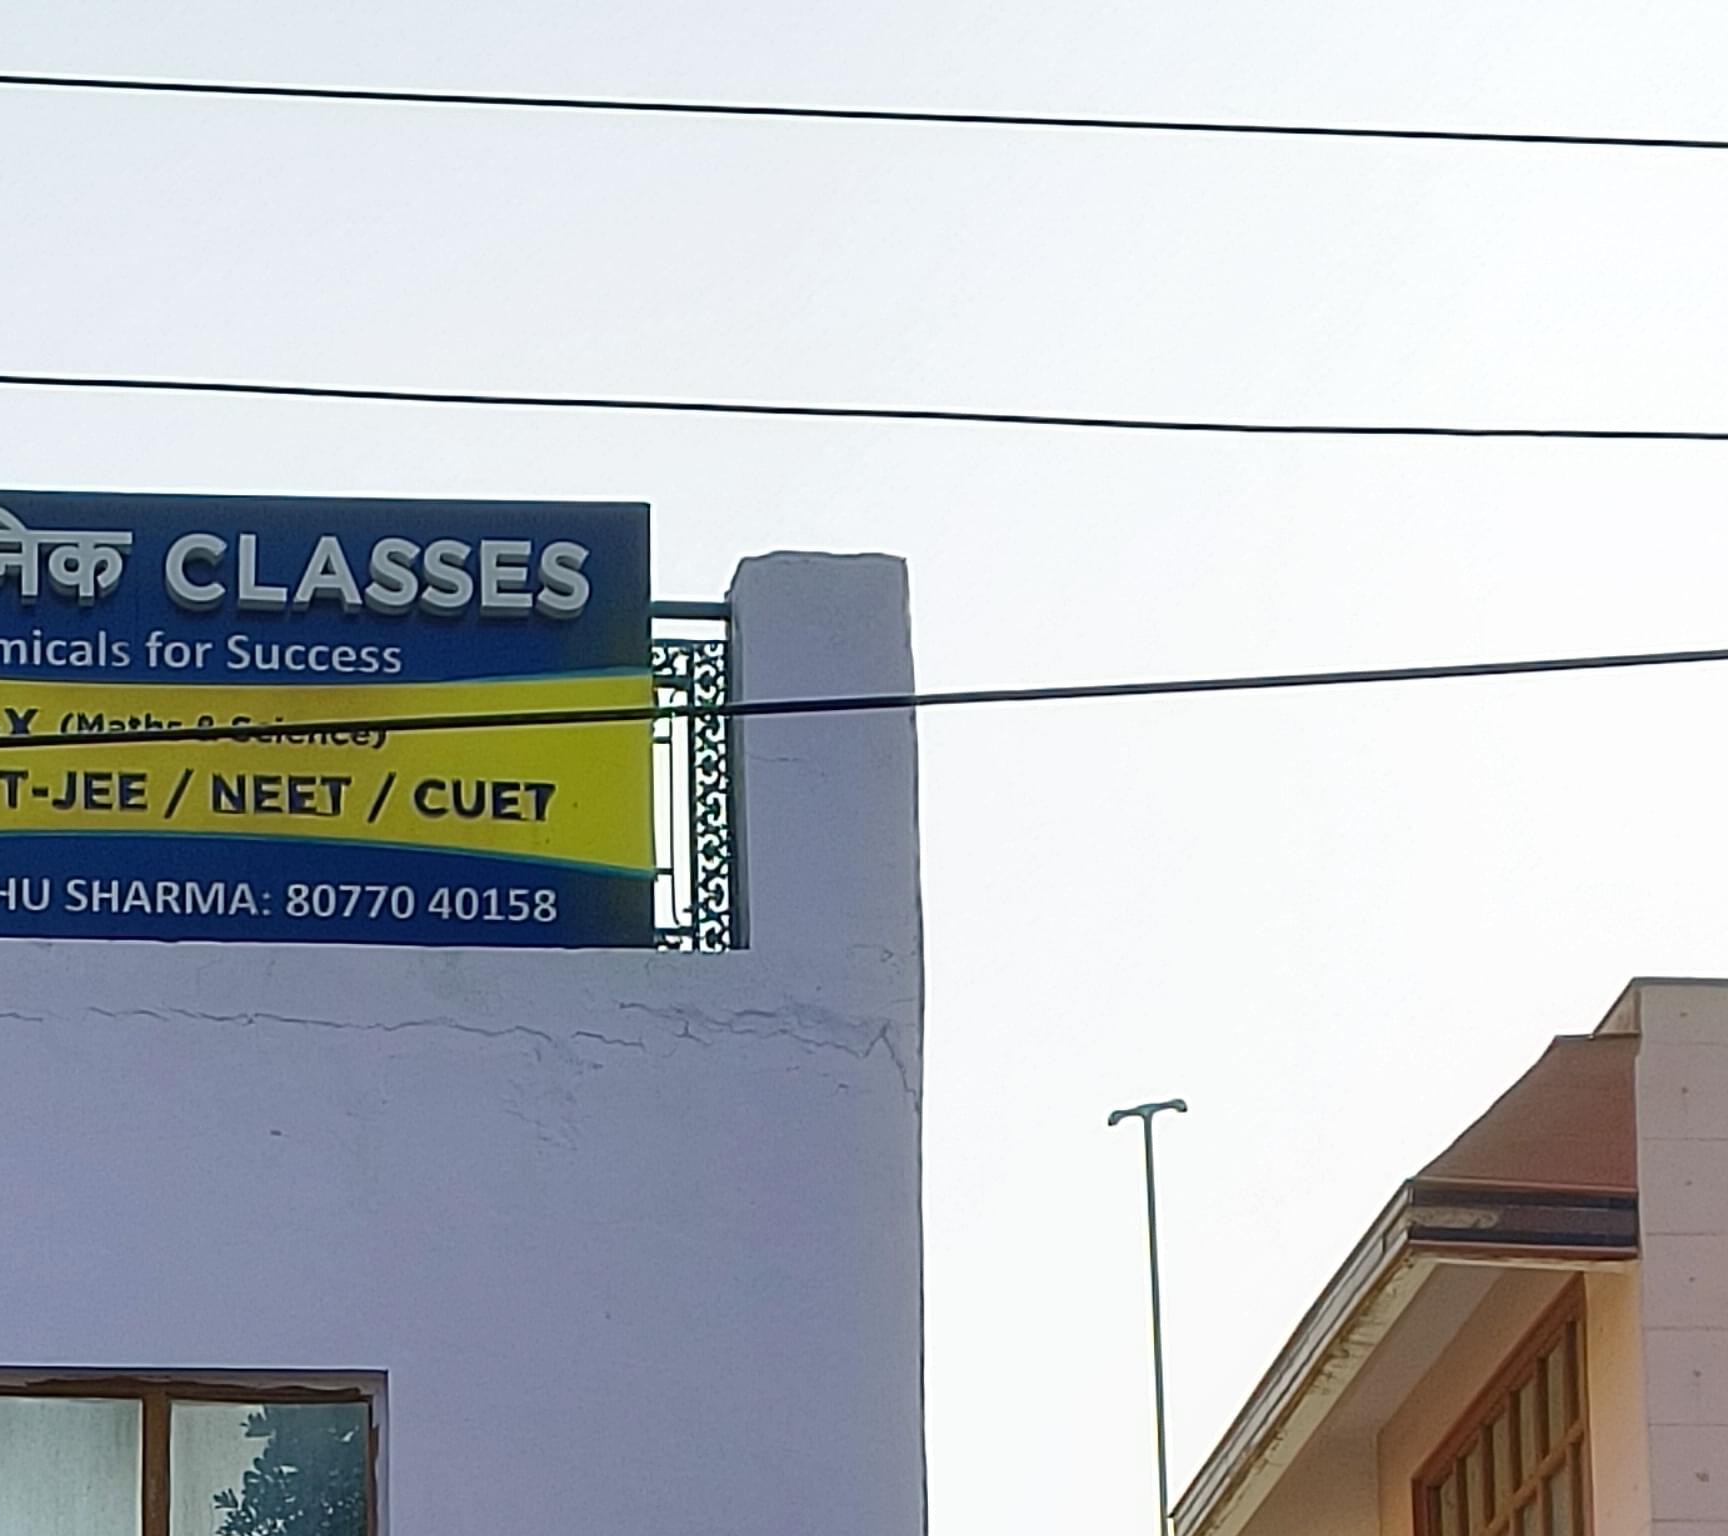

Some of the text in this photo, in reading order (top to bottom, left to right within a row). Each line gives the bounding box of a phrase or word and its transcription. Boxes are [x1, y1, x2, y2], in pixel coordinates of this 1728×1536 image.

[164, 532, 591, 620] CLASSES
[146, 630, 213, 669] for
[226, 634, 402, 674] Success
[164, 768, 194, 819] /
[212, 773, 352, 816] NEET
[367, 772, 397, 824] /
[413, 779, 557, 822] CUET
[65, 879, 271, 917] SHARMA:
[285, 884, 415, 919] 80770
[428, 887, 558, 922] 40158
